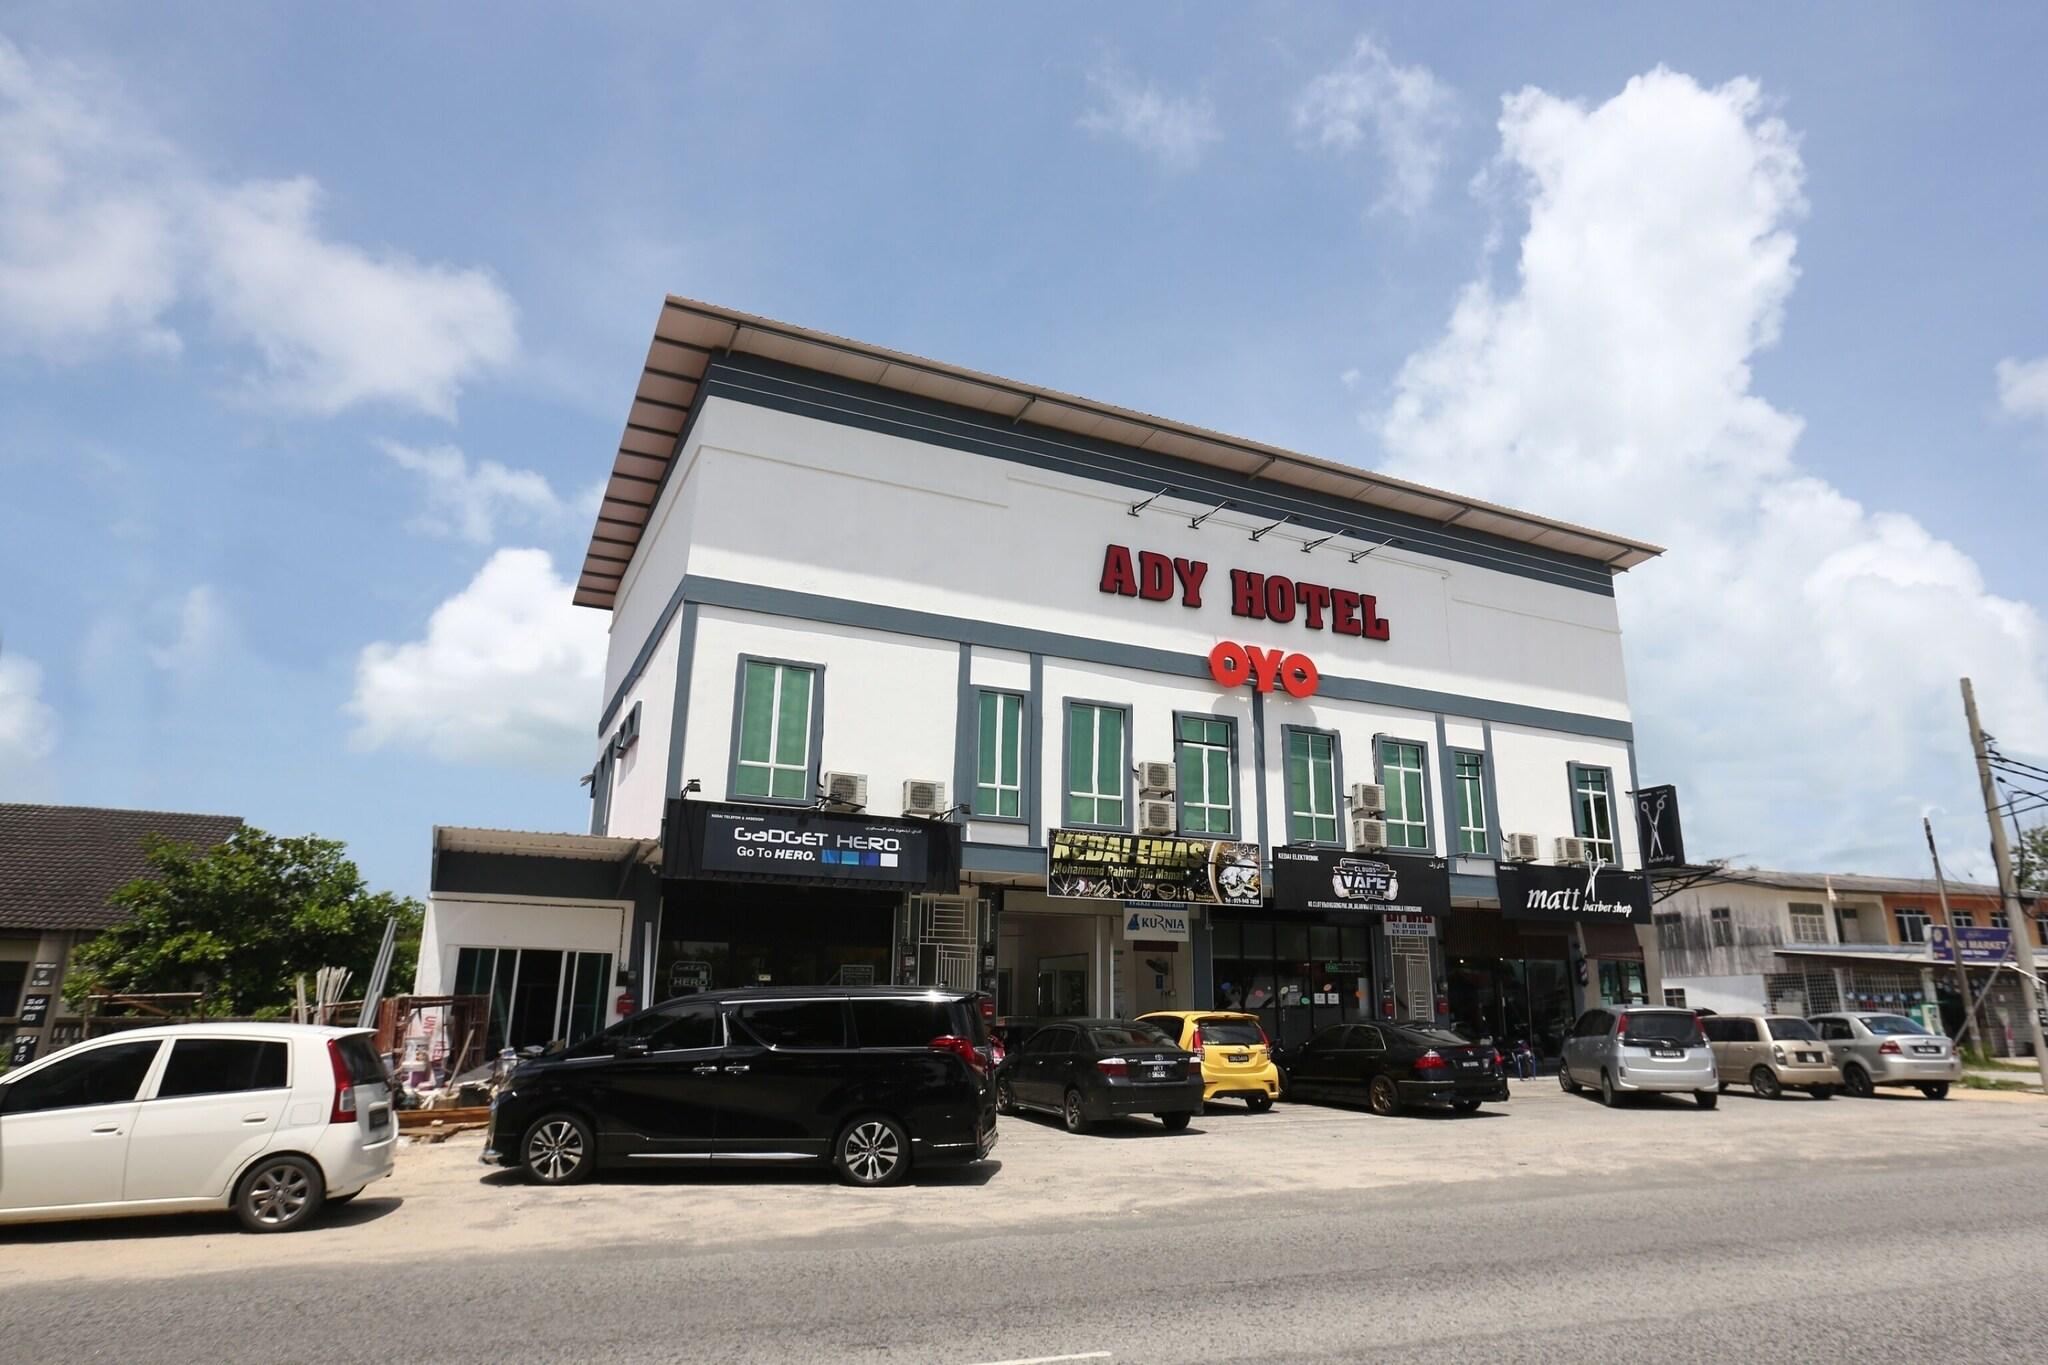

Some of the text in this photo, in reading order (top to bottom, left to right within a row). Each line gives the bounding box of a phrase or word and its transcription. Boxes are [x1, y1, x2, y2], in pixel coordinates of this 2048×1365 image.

[1099, 543, 1390, 641] ADY HOTEL
[1208, 640, 1320, 698] OYO
[736, 846, 816, 862] Go To HERO.
[1053, 832, 1205, 867] KEDAI EMAS
[1108, 865, 1137, 878] Rahimi
[1341, 871, 1389, 889] VAPE
[1526, 888, 1581, 911] matt
[1582, 900, 1633, 918] barber shop
[1142, 913, 1185, 932] KURNIA
